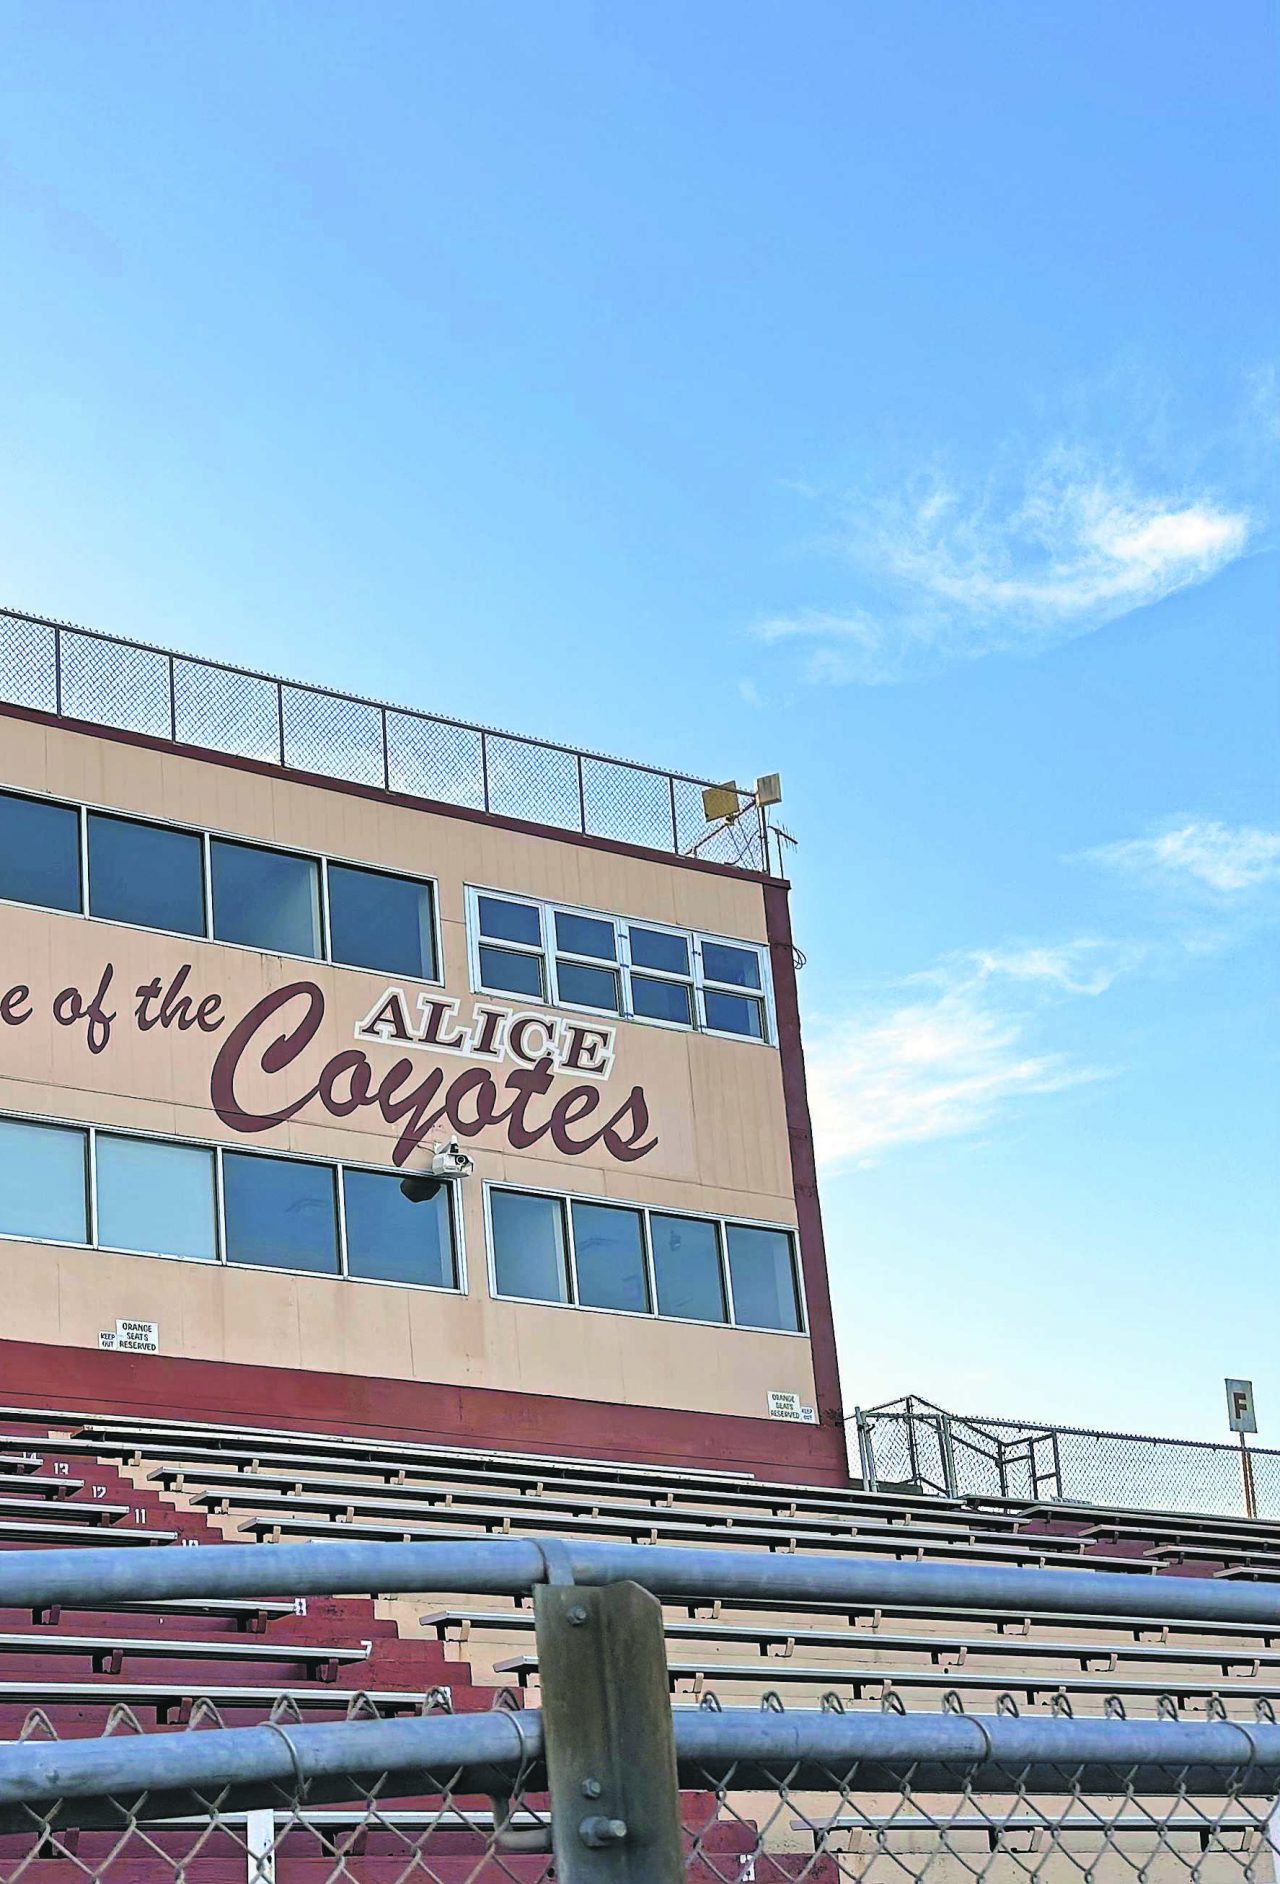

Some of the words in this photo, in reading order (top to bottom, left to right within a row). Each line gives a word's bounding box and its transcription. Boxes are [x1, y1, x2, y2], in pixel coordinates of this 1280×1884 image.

[53, 963, 118, 1054] of
[135, 964, 225, 1032] the
[354, 986, 616, 1081] ALICE
[210, 981, 658, 1168] Coyotes
[122, 1322, 152, 1333] ORANGE
[126, 1332, 149, 1341] SEATS
[119, 1340, 156, 1351] RESERVED
[1233, 1392, 1247, 1419] F
[92, 1486, 106, 1499] 12
[134, 1508, 146, 1524] 11
